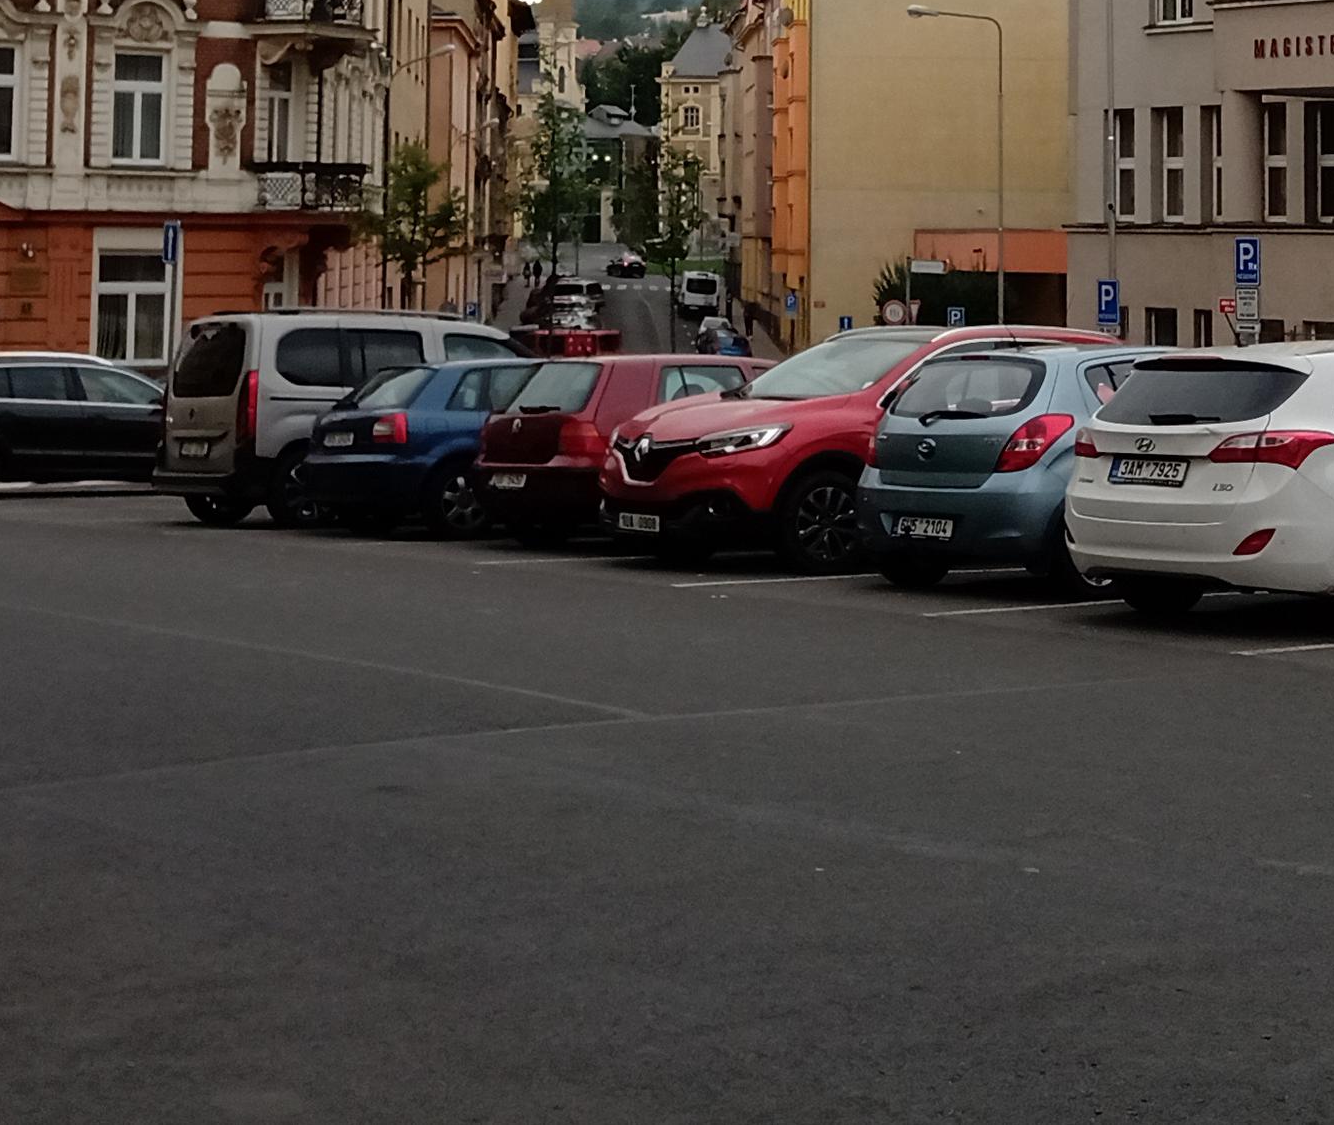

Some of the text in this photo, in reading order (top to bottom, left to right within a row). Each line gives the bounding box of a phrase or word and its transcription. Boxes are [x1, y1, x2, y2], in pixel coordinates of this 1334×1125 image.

[1239, 243, 1254, 270] P
[787, 296, 795, 307] P
[1101, 285, 1114, 310] P
[951, 311, 961, 324] P
[1149, 462, 1182, 479] 7925
